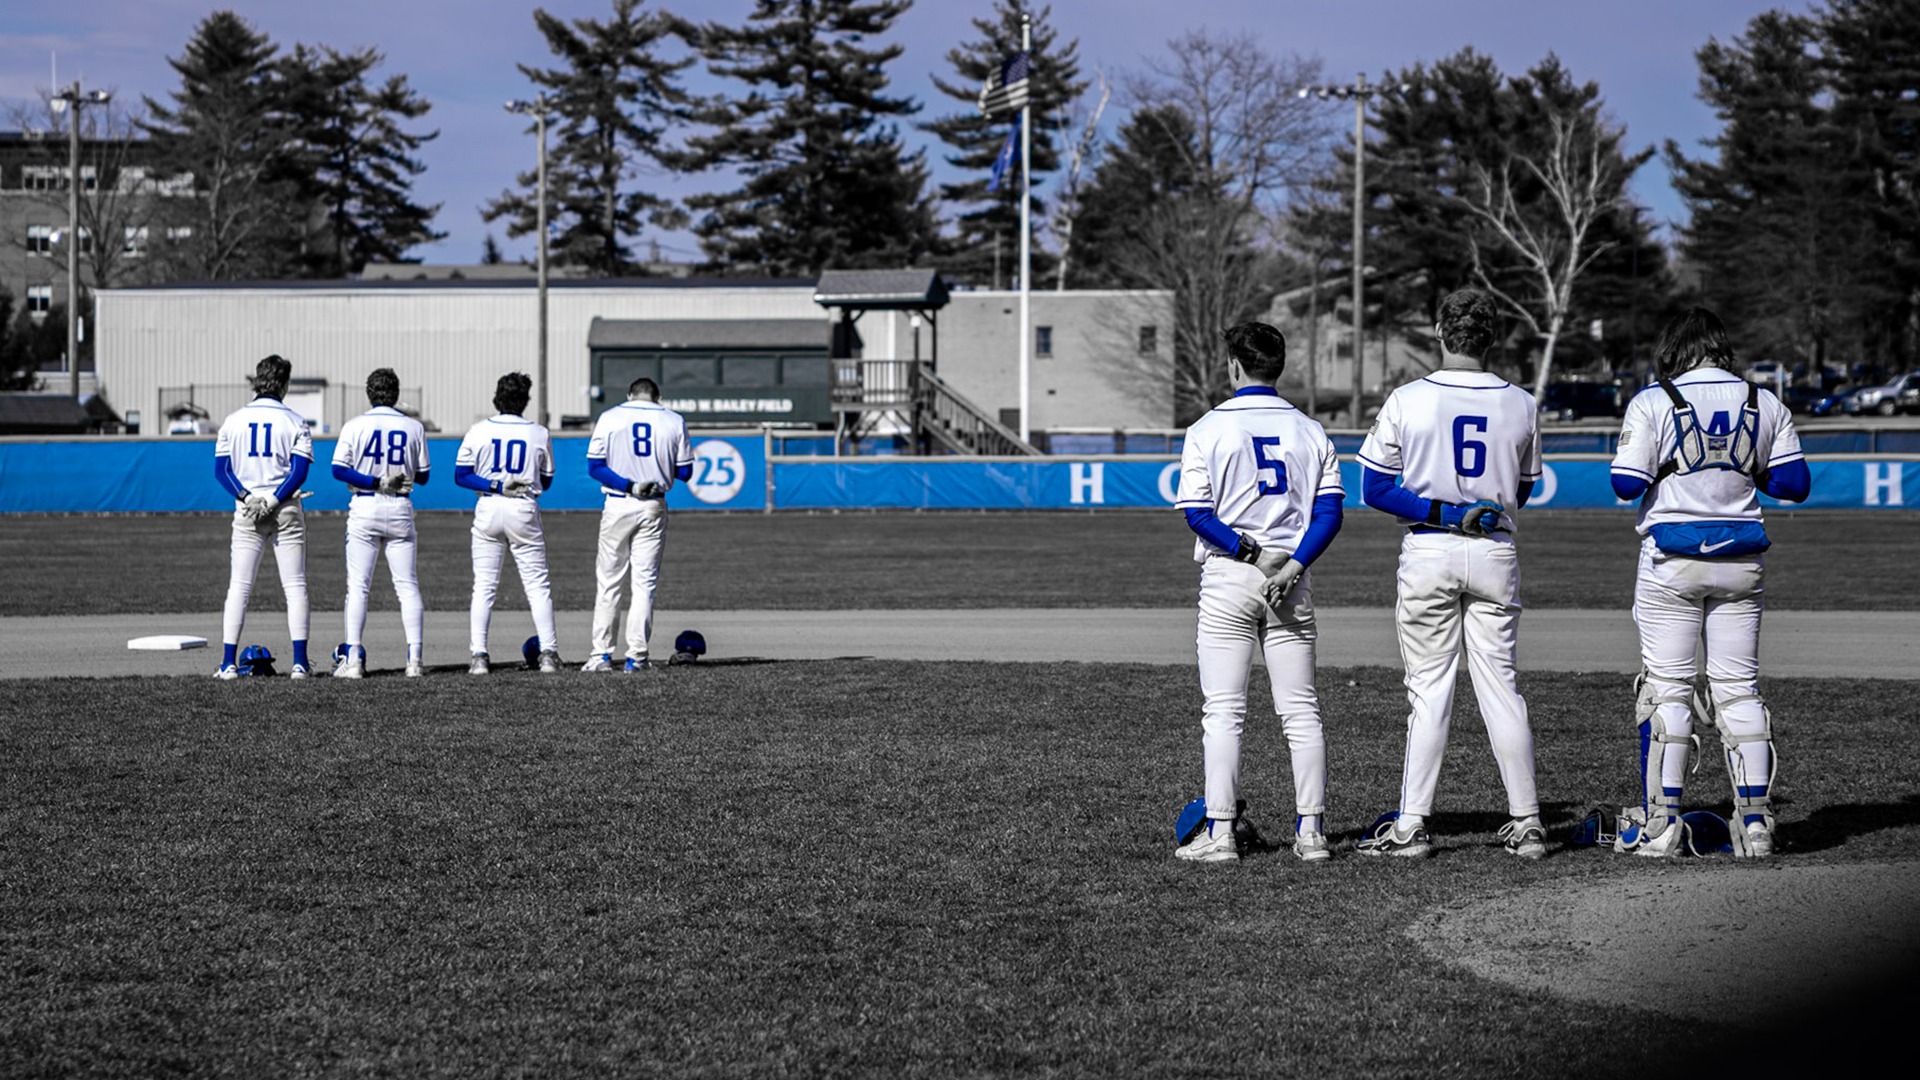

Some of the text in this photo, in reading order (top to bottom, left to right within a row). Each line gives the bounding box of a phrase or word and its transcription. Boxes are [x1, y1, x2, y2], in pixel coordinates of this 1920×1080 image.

[713, 399, 756, 412] BAILEY
[757, 399, 793, 412] FIELD
[1698, 384, 1742, 400] FRINK
[248, 423, 272, 457] 11
[364, 429, 407, 466] 48
[491, 438, 527, 474] 10
[632, 422, 651, 457] 8
[1453, 415, 1488, 478] 6
[696, 456, 736, 486] 25
[1252, 436, 1288, 496] 5
